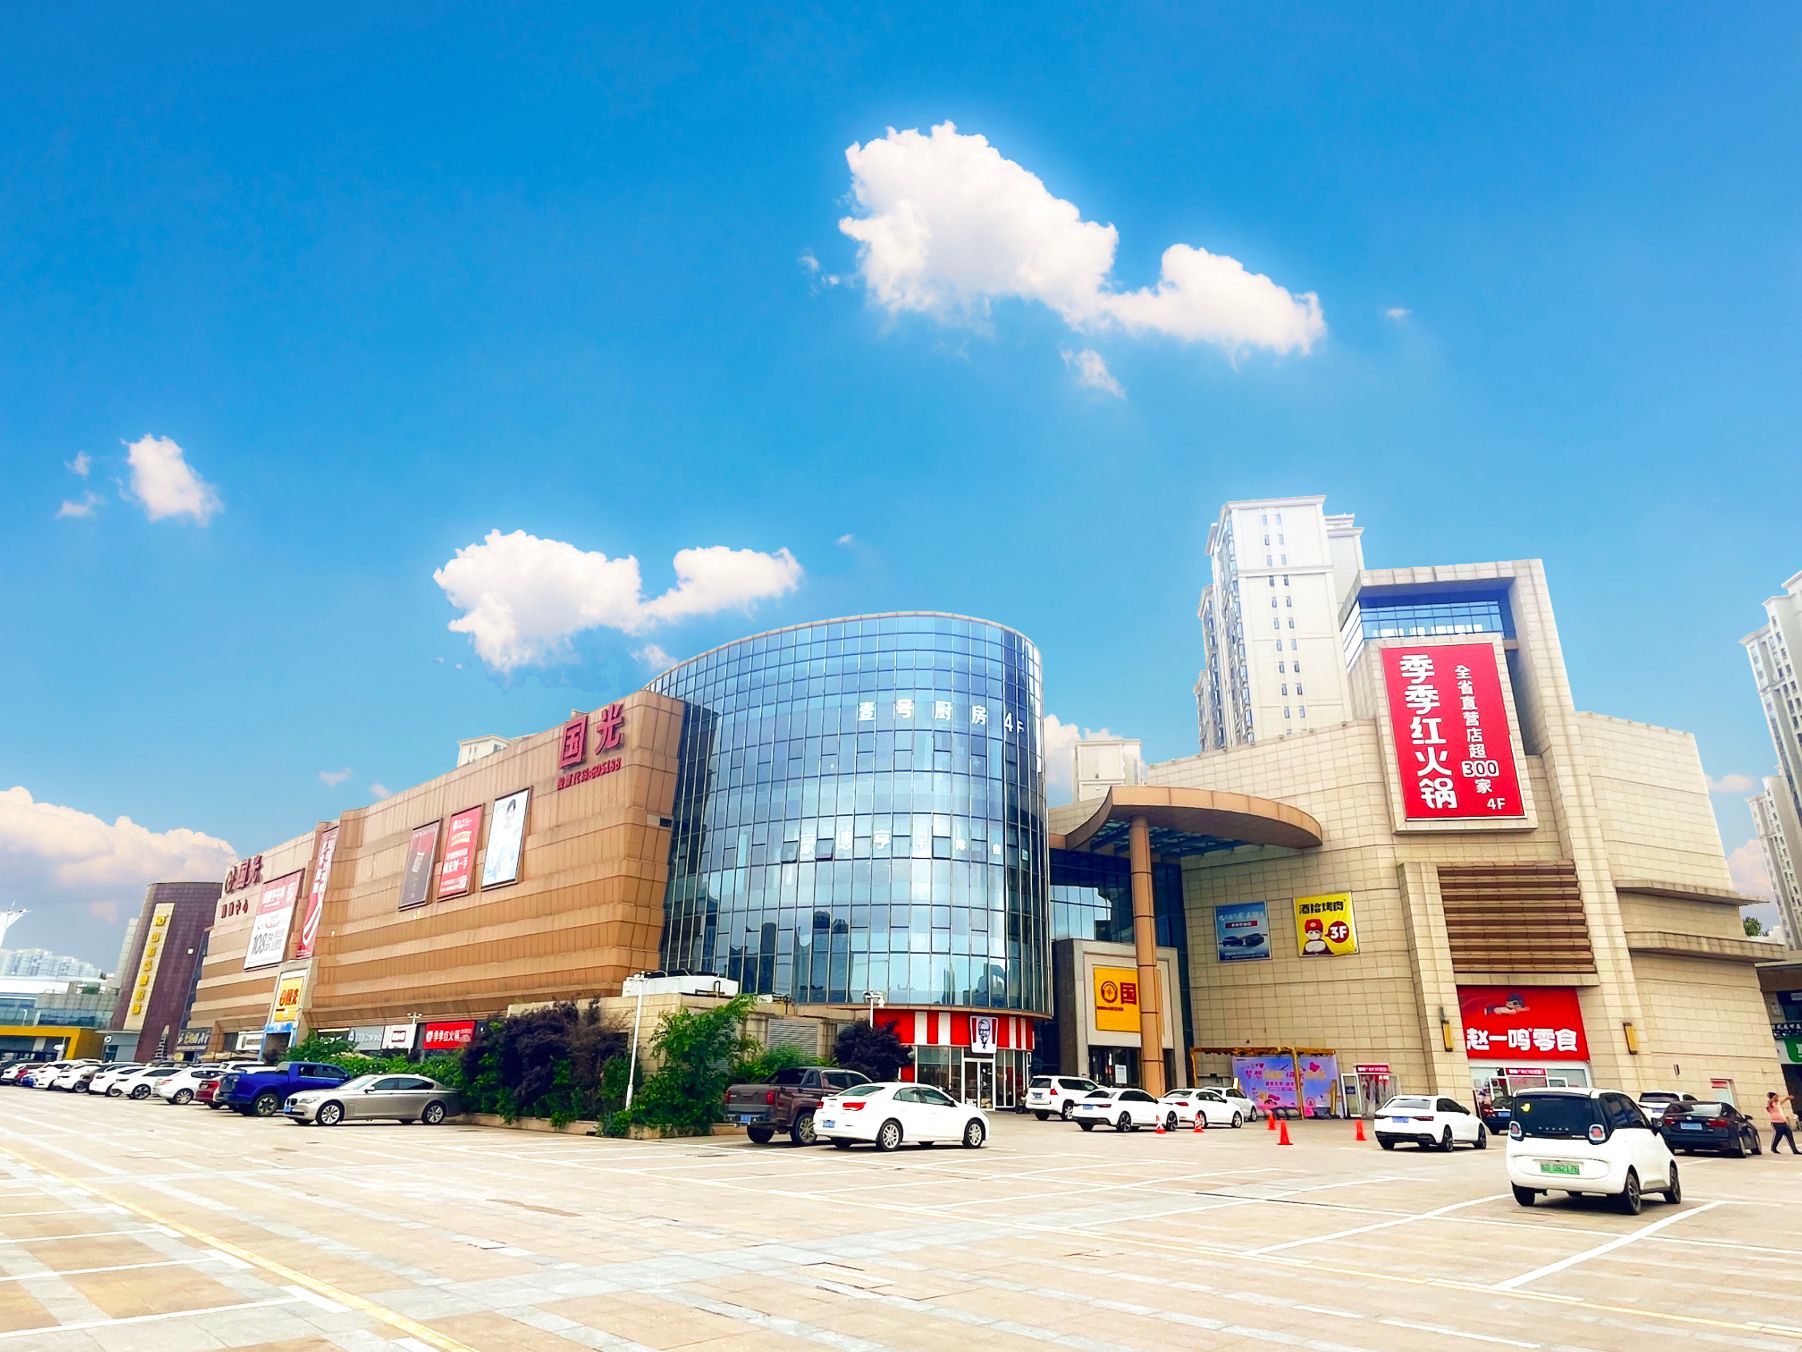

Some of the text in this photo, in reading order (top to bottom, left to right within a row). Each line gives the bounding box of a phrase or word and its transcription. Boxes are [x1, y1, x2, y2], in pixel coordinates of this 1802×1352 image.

[858, 698, 987, 725] 壹号厨房
[560, 703, 625, 770] 国光
[1400, 654, 1458, 809] 季季红火锅
[1487, 798, 1506, 810] 4F
[1329, 925, 1347, 939] 3F
[1467, 1028, 1577, 1051] 赵一鸣零食
